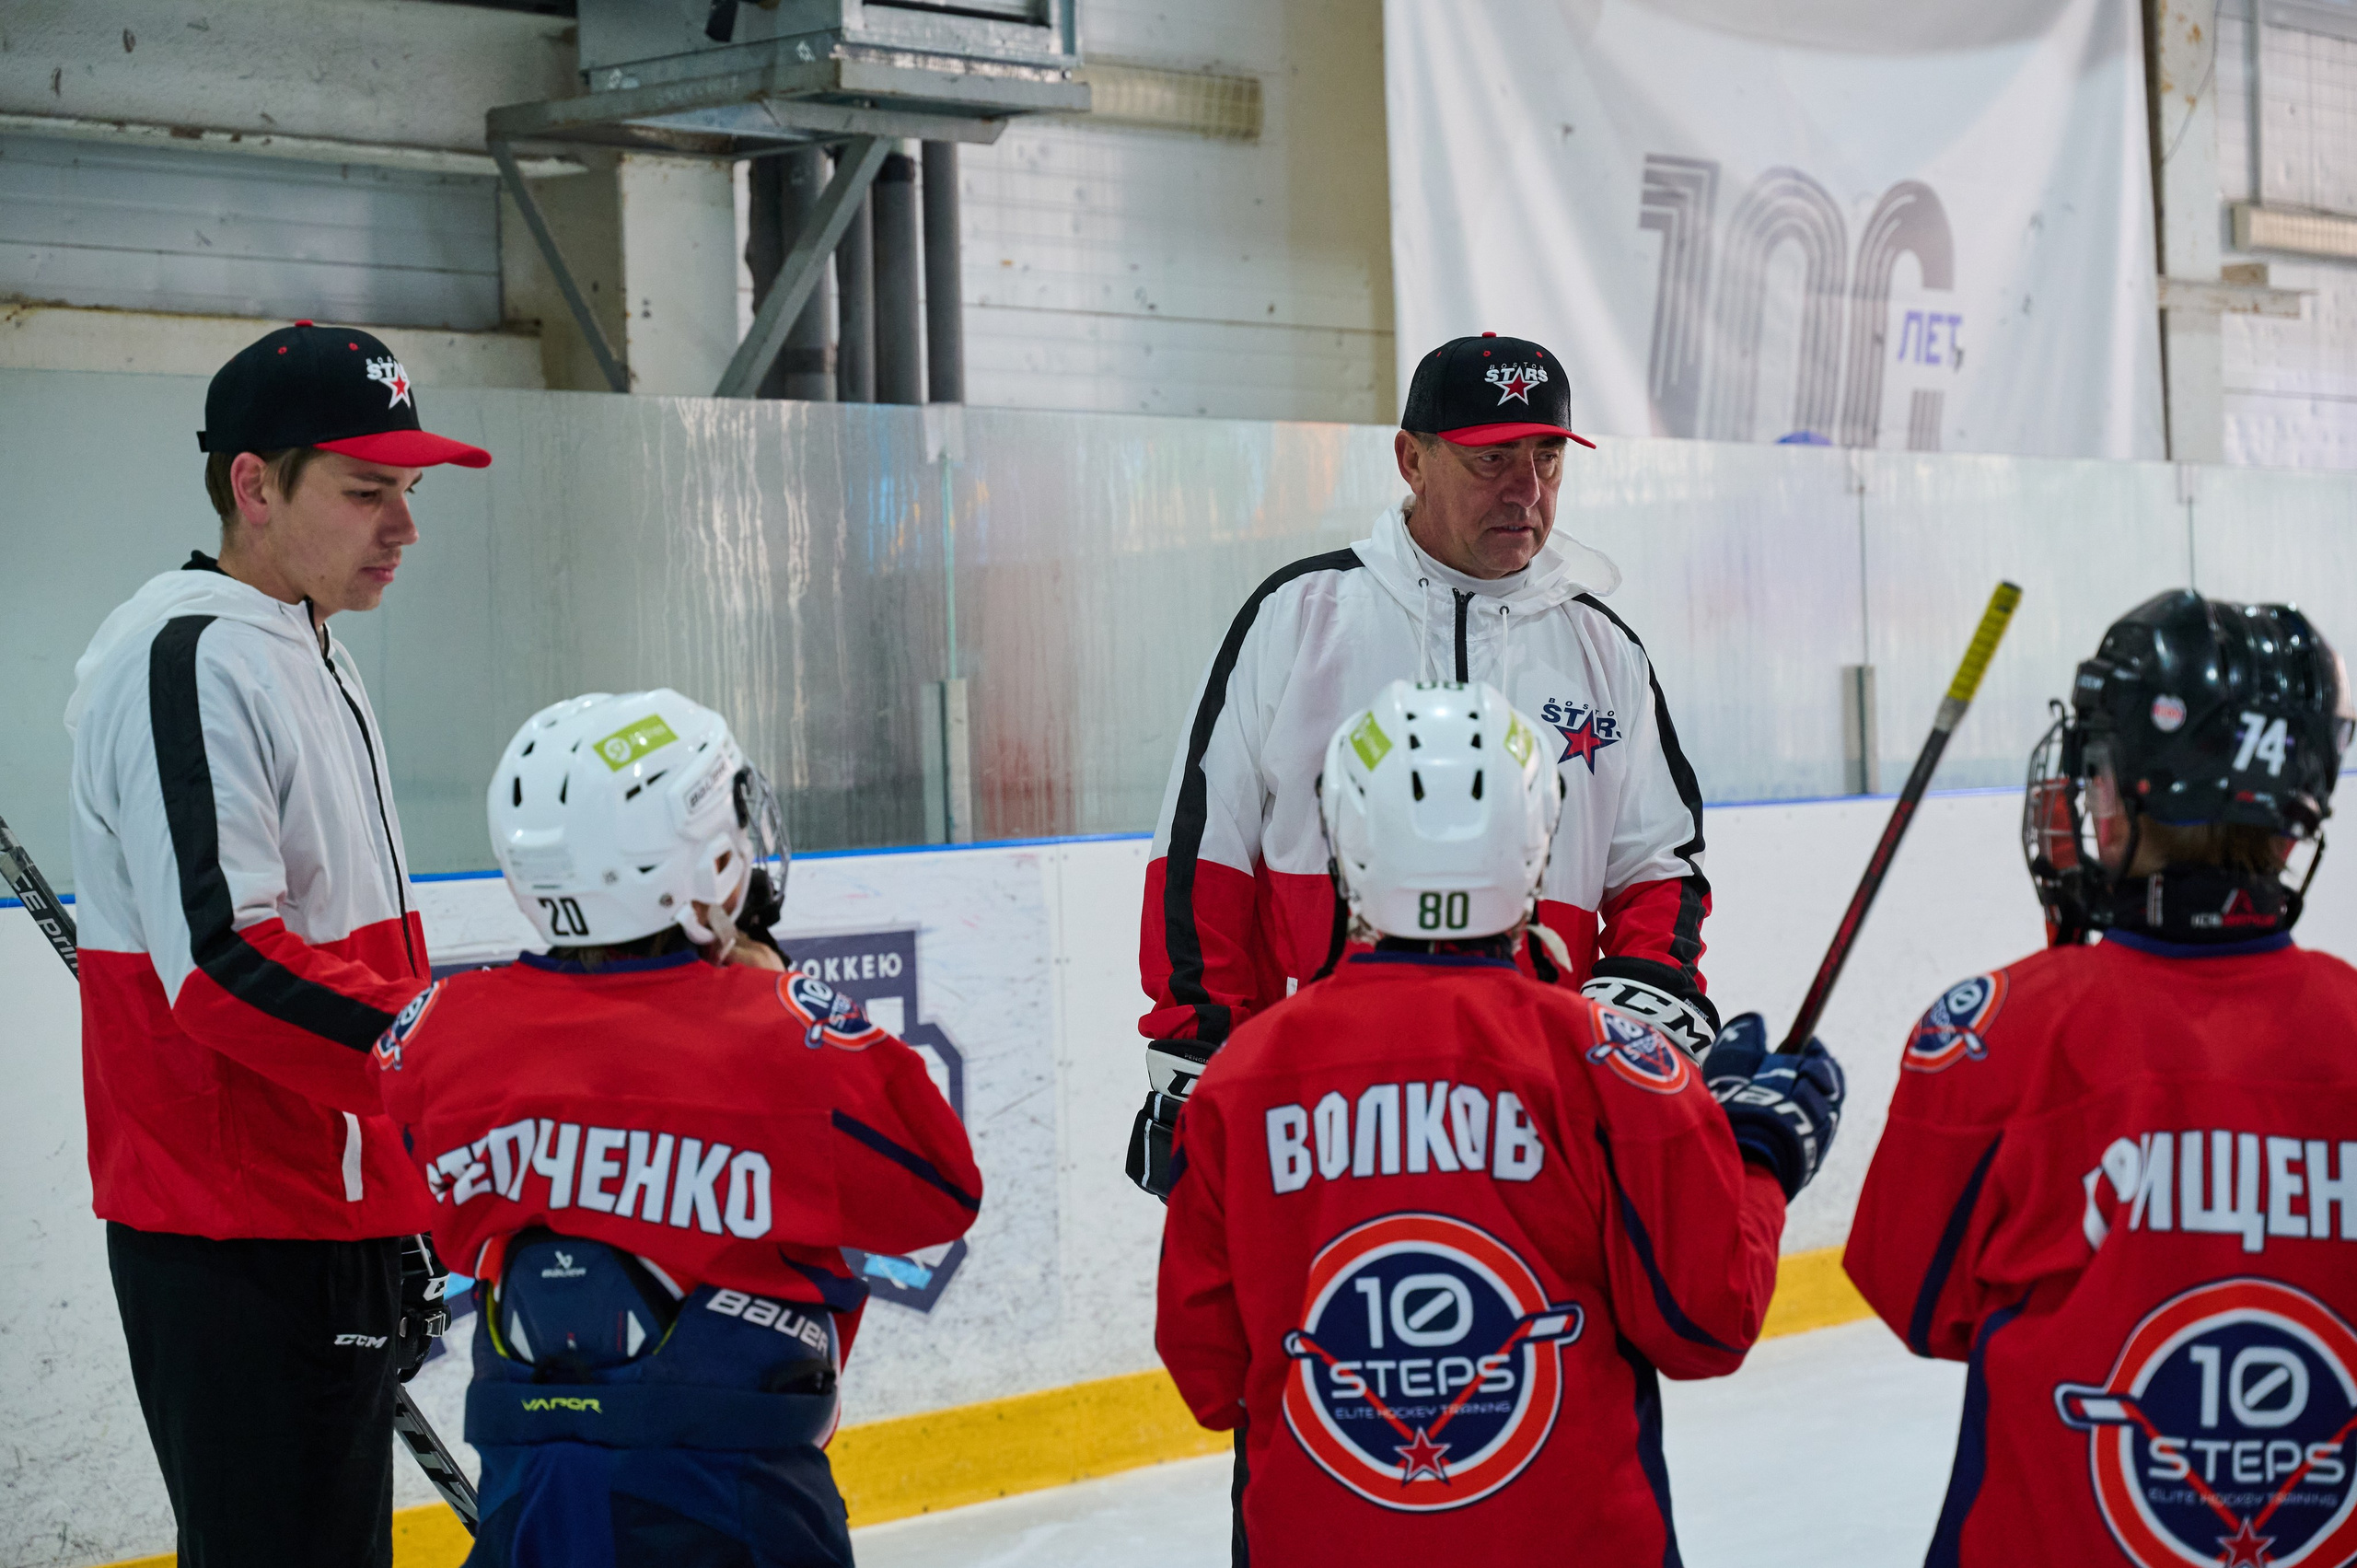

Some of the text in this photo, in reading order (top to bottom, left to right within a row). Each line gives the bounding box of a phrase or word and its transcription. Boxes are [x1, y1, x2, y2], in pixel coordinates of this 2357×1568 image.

[1484, 366, 1549, 387] STARS
[1548, 697, 1615, 717] BOSTO
[2232, 712, 2289, 777] 74
[538, 898, 589, 936] 20
[1418, 890, 1469, 930] 80
[1265, 1079, 1545, 1195] ВОЛКОВ
[1355, 1273, 1473, 1348] 10
[333, 1334, 388, 1349] CCM
[1329, 1354, 1515, 1400] STEPS
[2189, 1345, 2310, 1429] 10
[521, 1397, 602, 1414] VAPOR
[2147, 1435, 2346, 1485] STEPS
